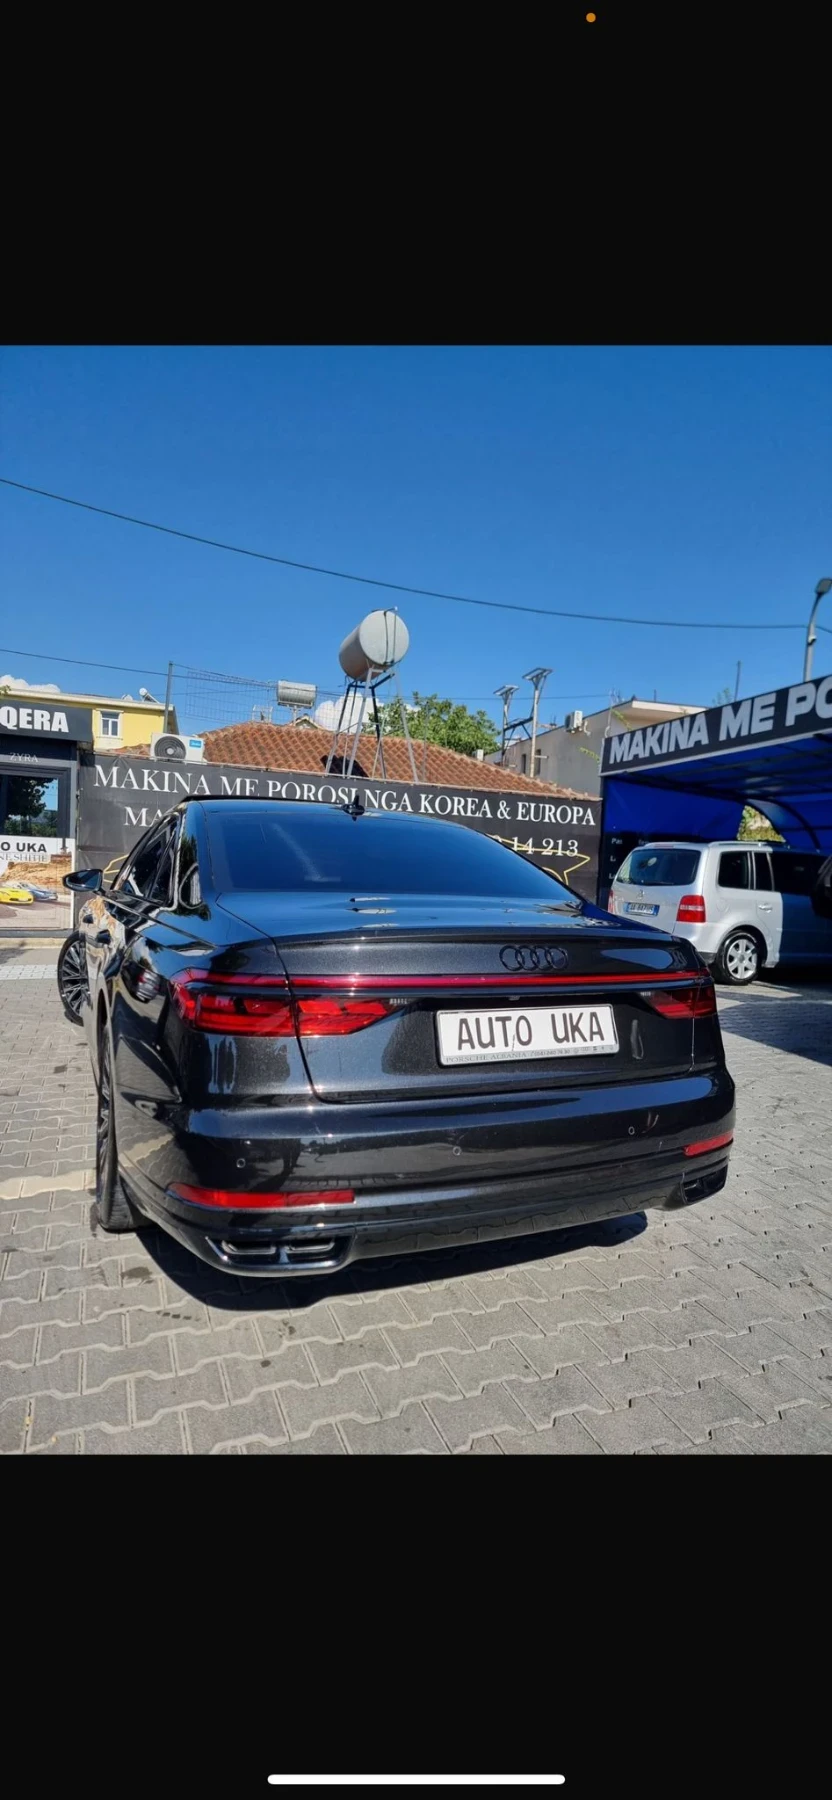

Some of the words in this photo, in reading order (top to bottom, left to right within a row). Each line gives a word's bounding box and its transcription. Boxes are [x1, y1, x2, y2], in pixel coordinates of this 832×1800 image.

[0, 706, 69, 733] QERA
[609, 713, 709, 765] MAKINA
[719, 692, 777, 742] ME
[9, 752, 39, 763] ZYRA
[93, 765, 212, 796] MAKINA
[364, 789, 413, 812] NGA
[418, 793, 493, 818] KOREA
[496, 800, 512, 820] &
[517, 801, 596, 826] EUROPA
[16, 842, 47, 853] UKA
[512, 836, 535, 854] 14
[541, 838, 578, 857] 213
[457, 1015, 533, 1051] AUTO
[551, 1011, 605, 1044] UKA
[446, 1053, 487, 1063] PORSCHE
